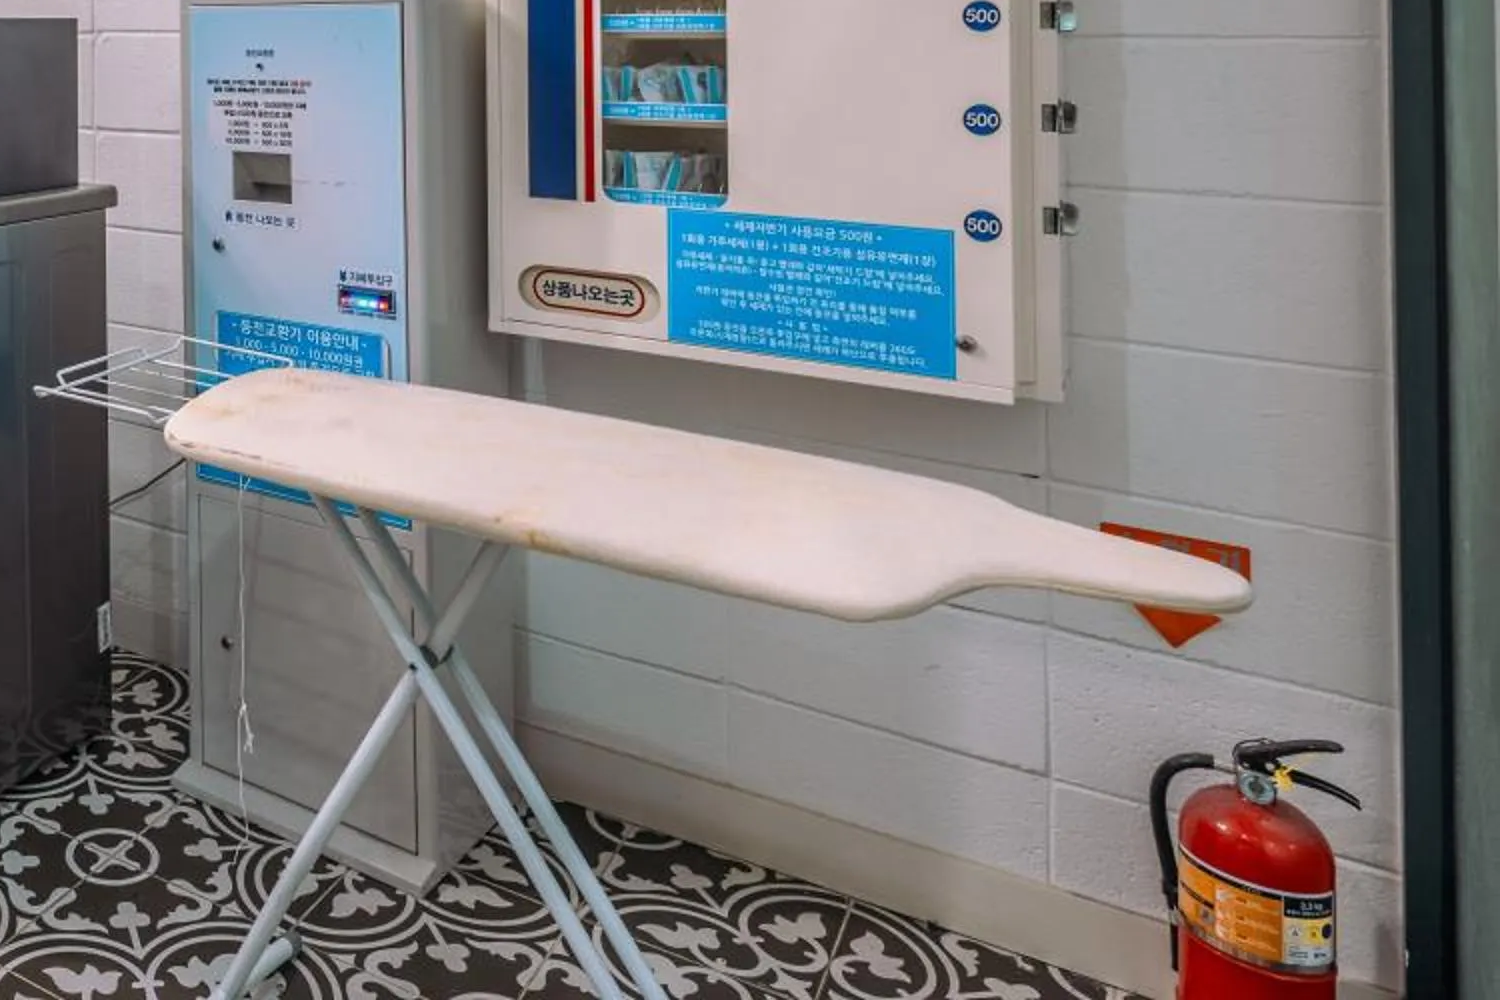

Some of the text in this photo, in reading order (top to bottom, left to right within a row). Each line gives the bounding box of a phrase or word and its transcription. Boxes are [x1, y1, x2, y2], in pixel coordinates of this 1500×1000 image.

[965, 9, 998, 24] 500
[966, 113, 999, 128] 500
[255, 214, 282, 227] 나오는
[966, 218, 999, 234] 500
[791, 224, 835, 240] 사용요금
[839, 228, 872, 243] 500원
[350, 272, 393, 286] 지폐투입구
[543, 280, 635, 307] 상품나오는곳
[240, 319, 359, 350] 동전교환기 이용안내
